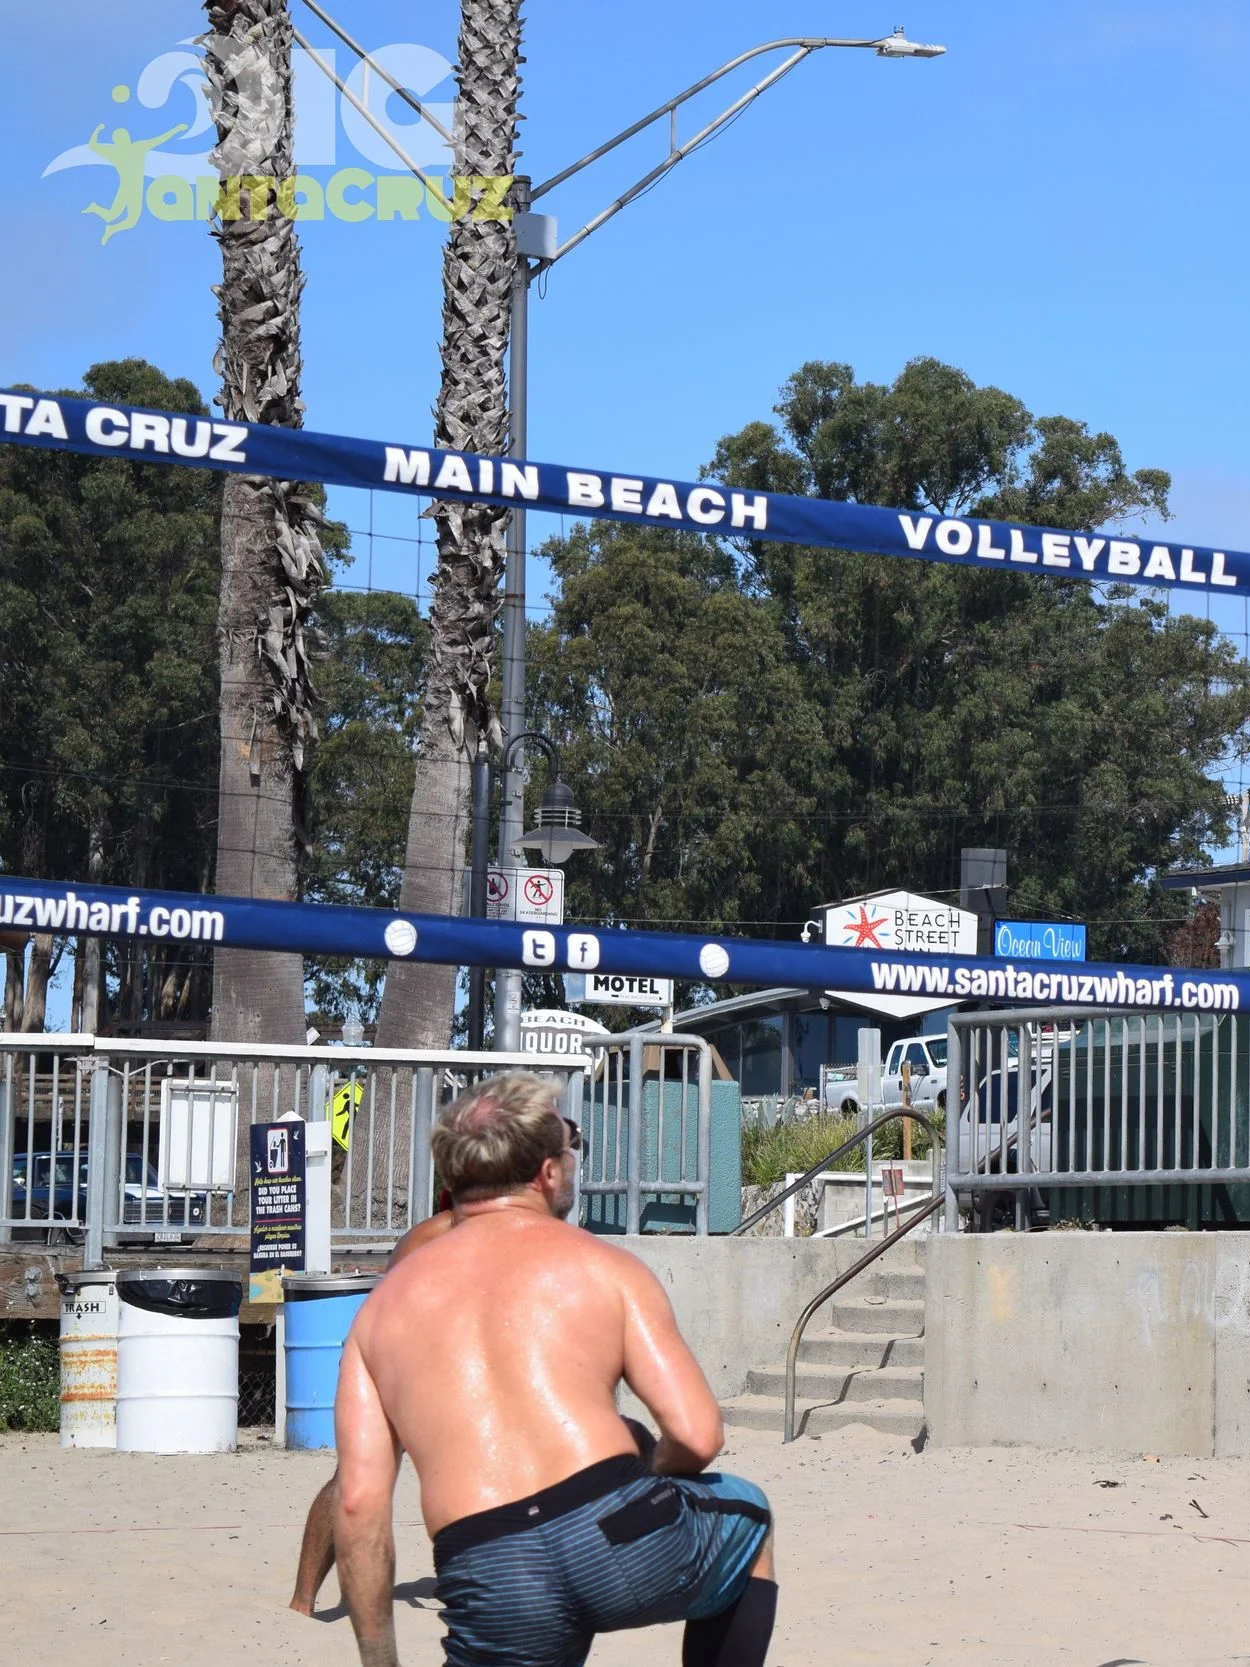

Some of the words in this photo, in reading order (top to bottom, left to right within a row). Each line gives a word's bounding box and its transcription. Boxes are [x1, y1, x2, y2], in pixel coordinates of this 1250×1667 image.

[0, 393, 68, 440] TA
[85, 406, 248, 463] CRUZ
[383, 446, 539, 500] MAIN
[566, 471, 767, 531] BEACH
[898, 514, 1237, 587] VOLLEYBALL
[895, 910, 960, 928] BEACH
[895, 929, 960, 946] STREET
[997, 924, 1041, 958] Ocean
[1043, 927, 1082, 958] View
[594, 975, 659, 994] MOTEL
[871, 962, 1239, 1010] www.santacruzwharf.com
[522, 1016, 585, 1027] BEACH
[258, 1187, 268, 1195] DID
[269, 1186, 280, 1194] YOU
[281, 1185, 297, 1194] PLACE
[258, 1196, 272, 1205] YOUR
[273, 1195, 289, 1204] LITTER
[291, 1195, 297, 1203] IN
[256, 1206, 265, 1215] THE
[266, 1205, 283, 1214] TRASH
[284, 1203, 301, 1213] CANS?
[65, 1303, 99, 1312] TRASH
